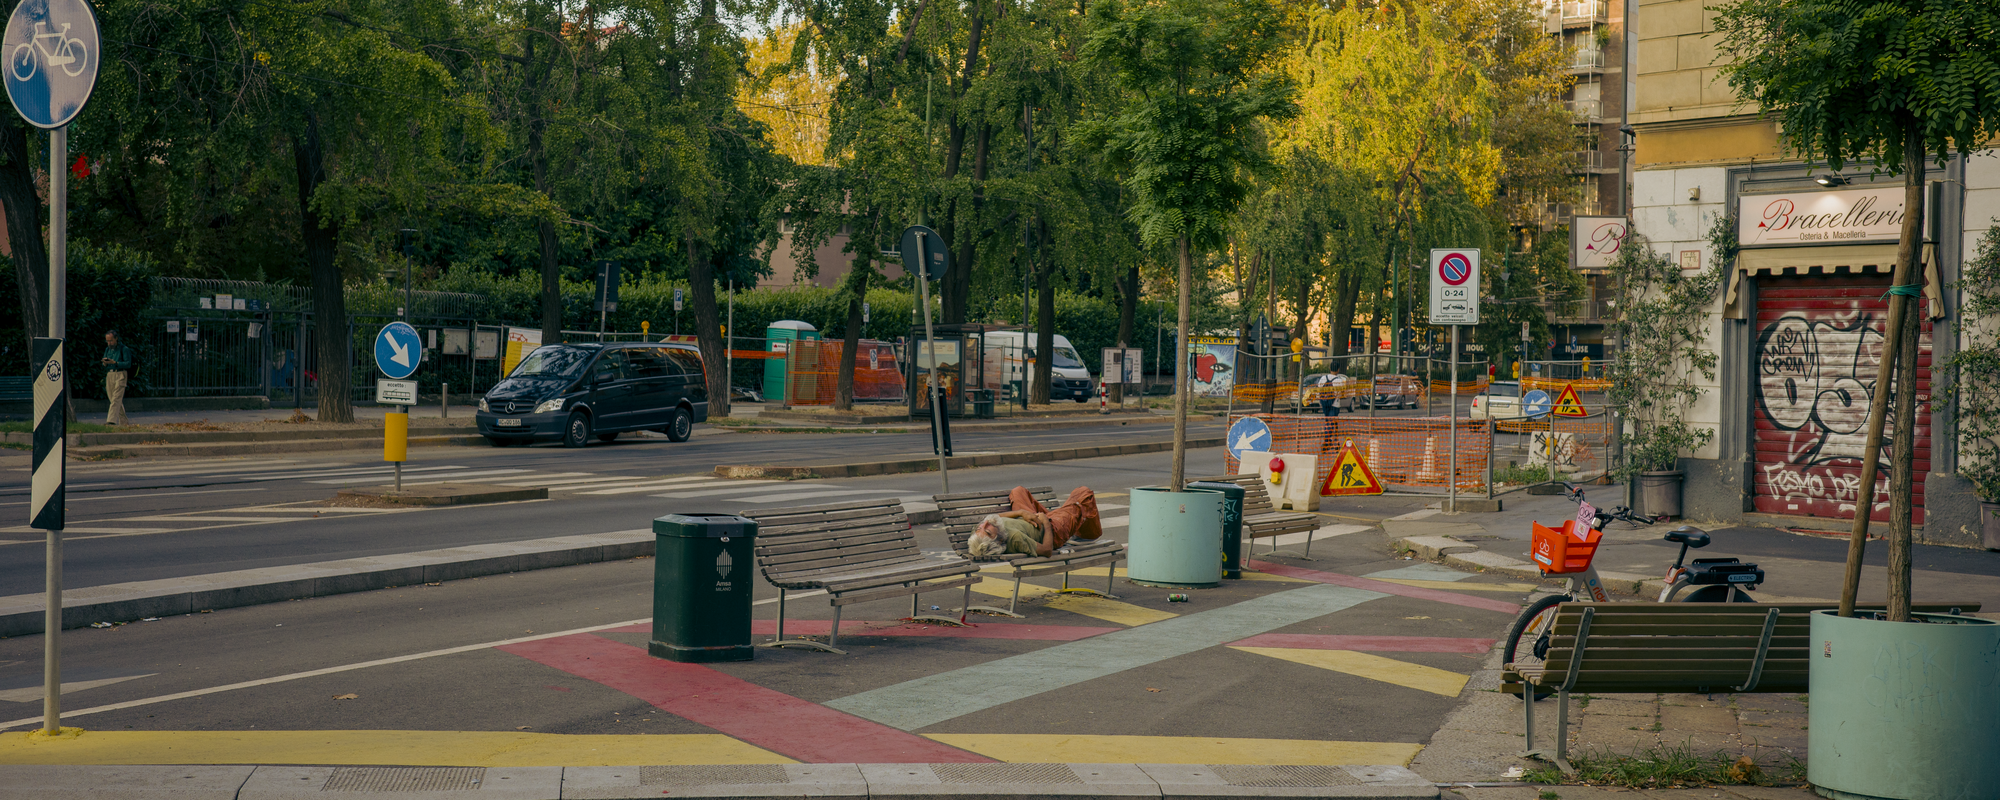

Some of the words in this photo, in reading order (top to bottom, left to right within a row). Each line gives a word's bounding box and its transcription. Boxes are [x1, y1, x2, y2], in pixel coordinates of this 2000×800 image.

[1799, 232, 1822, 241] Osteria
[1823, 231, 1829, 240] &
[1832, 229, 1866, 239] Macelleria
[1565, 345, 1589, 353] HUSE
